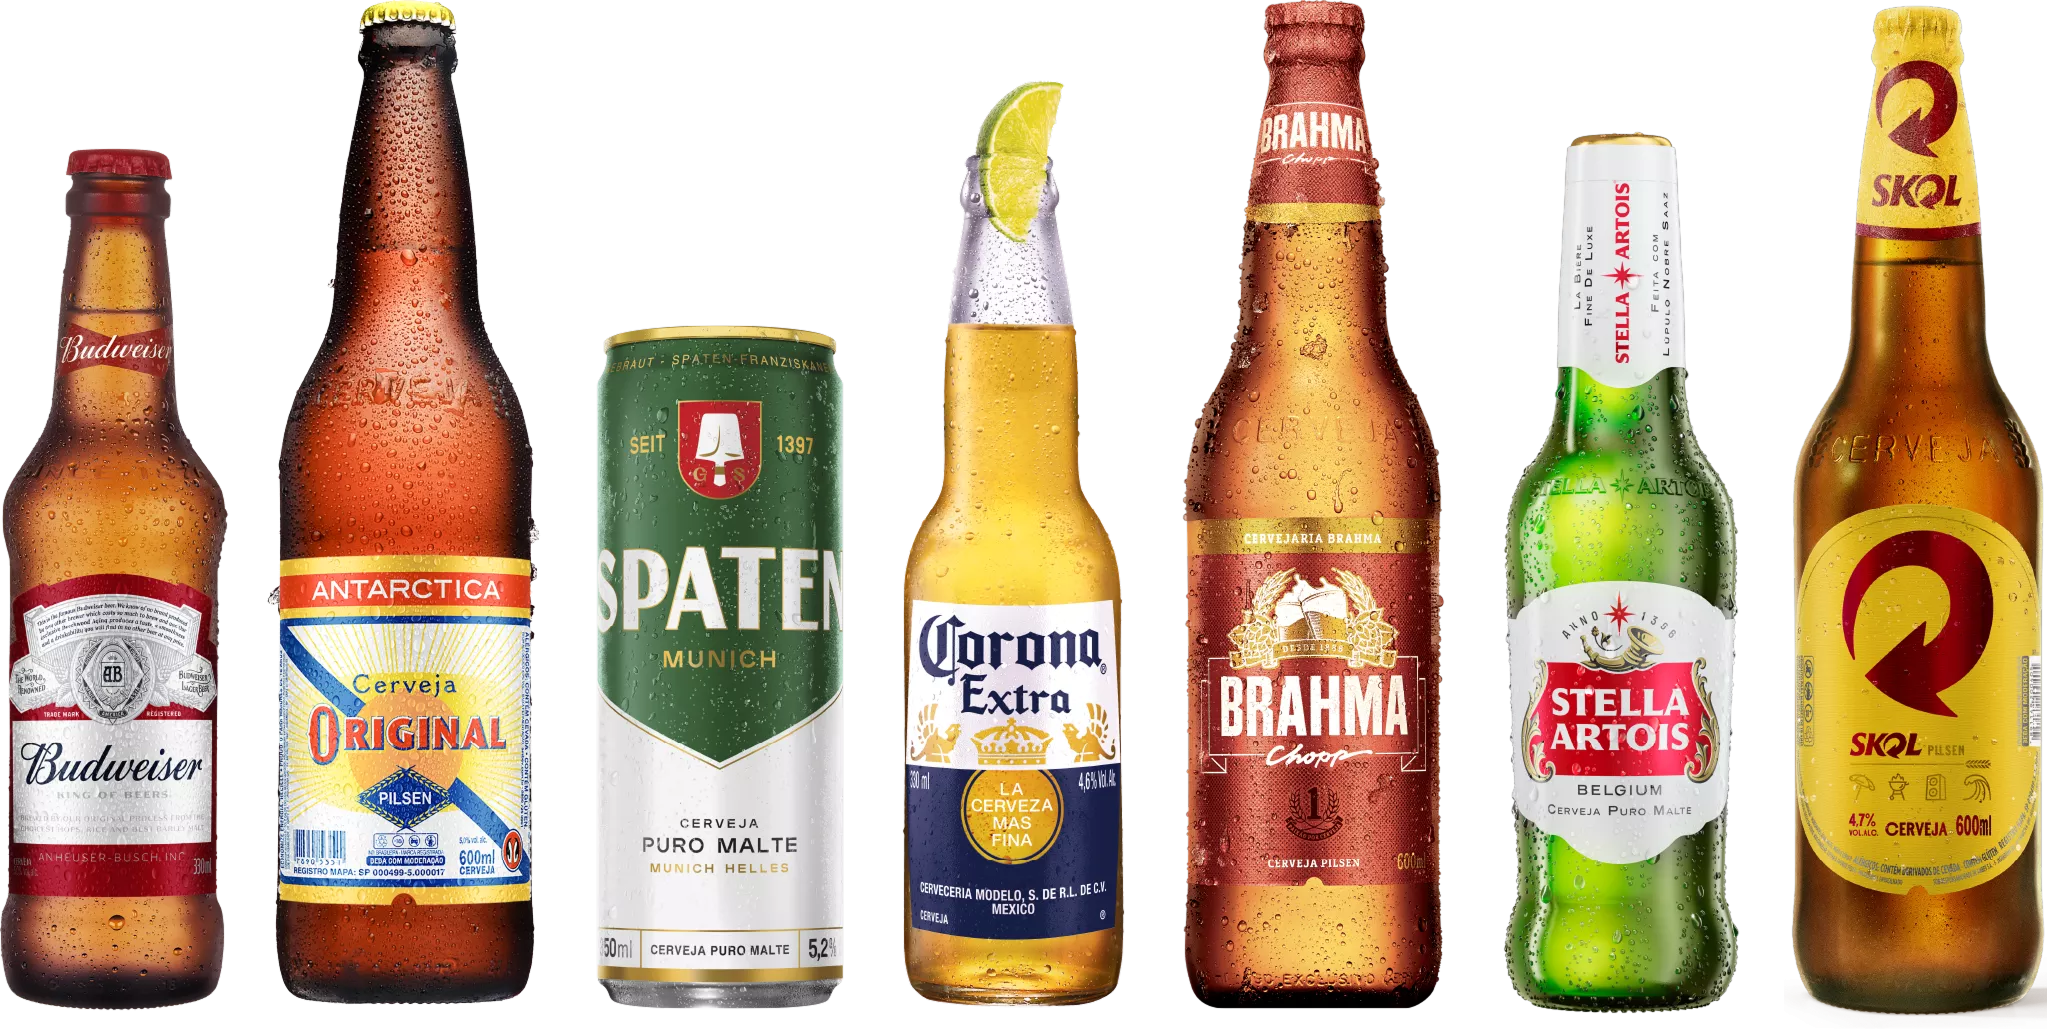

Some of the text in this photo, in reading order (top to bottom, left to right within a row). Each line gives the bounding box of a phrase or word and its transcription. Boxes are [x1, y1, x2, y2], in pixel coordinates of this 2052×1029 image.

[1260, 111, 1367, 154] BRAHMA
[1871, 173, 1962, 210] SKOL
[1614, 182, 1630, 364] STELLA ARTOIS
[60, 334, 171, 363] Budweiser
[629, 434, 666, 455] SEIT
[776, 435, 815, 455] 1397
[1831, 434, 2000, 463] CERVEJA
[693, 466, 746, 483] G S
[1244, 533, 1382, 545] CERVEJARIA BRAHMA
[311, 578, 501, 602] ANTARCTICA
[597, 546, 844, 633] SPATEN
[1561, 610, 1599, 640] ANNO
[918, 614, 1102, 687] Corona
[1282, 643, 1316, 653] DESDE
[663, 650, 777, 669] MUNICH
[15, 674, 24, 683] THE
[103, 665, 123, 682] AB
[18, 685, 46, 696] RENOWNED
[353, 673, 458, 698] Cerveja
[959, 673, 1072, 716] Extra
[1220, 674, 1409, 737] BRAHMA
[1551, 687, 1690, 717] STELLA
[307, 703, 508, 766] ORIGINAL
[1550, 723, 1690, 752] ARTOIS
[1849, 732, 1922, 759] SKOL
[1927, 744, 1965, 756] PILSEN
[20, 741, 203, 786] Budweiser
[1265, 743, 1373, 768] Chopp
[909, 770, 930, 790] 330 ml
[1000, 782, 1024, 796] LA
[1078, 771, 1098, 794] 4,6%
[57, 790, 168, 799] KING OF BEERS
[379, 791, 433, 806] PILSEN
[1577, 784, 1663, 796] BELGIUM
[971, 799, 1054, 813] CERVEZA
[1307, 787, 1321, 820] 1
[680, 818, 759, 829] CERVEJA
[992, 816, 1032, 830] MAS
[1849, 813, 1876, 827] 4,7%
[1885, 821, 1948, 836] CERVEJA
[1956, 815, 1992, 836] 600ml
[642, 837, 798, 854] PURO MALTE
[991, 833, 1033, 847] FINA
[193, 857, 212, 875] 330ml
[388, 857, 403, 865] COM
[404, 856, 444, 866] MODERAÇÃO
[459, 849, 495, 865] 600ml
[1267, 858, 1360, 868] CERVEJA PILSEN
[1397, 852, 1427, 870] 600ml
[293, 866, 329, 876] REGISTRO
[330, 868, 357, 876] MAPA:
[459, 865, 495, 875] CERVEJA
[650, 863, 790, 874] MUNICH HELLES
[1880, 863, 1901, 875] CONTÉM
[920, 880, 1107, 903] CERVECERIA MODELO, S. DE R.L. DE C.V.
[920, 909, 949, 925] CERVEJA
[991, 903, 1036, 916] MEXICO
[650, 944, 790, 956] CERVEJA PURO MALTE
[808, 937, 837, 961] 5,2%
